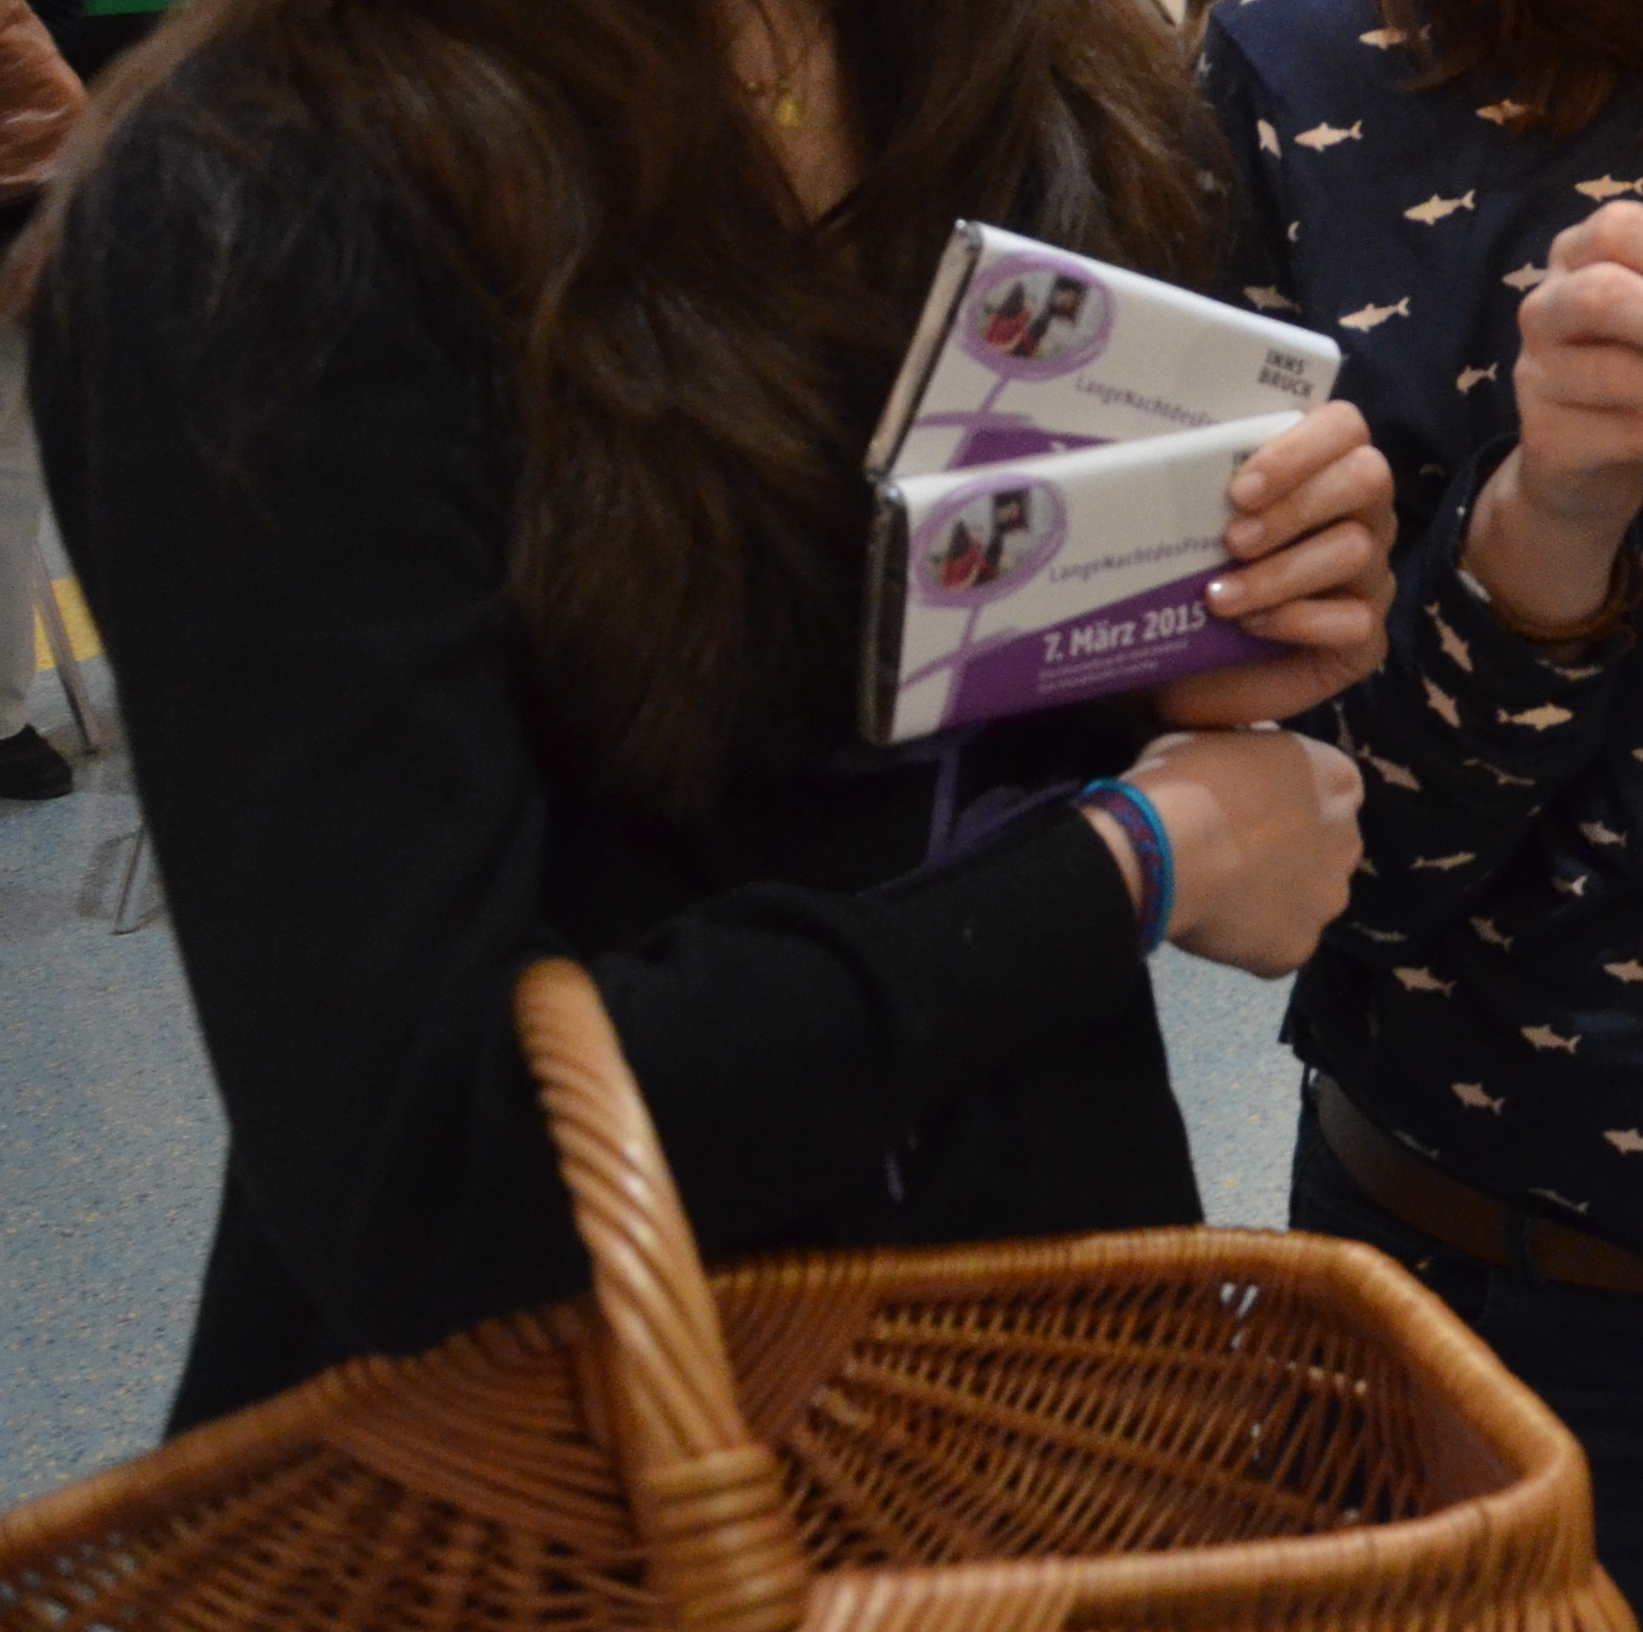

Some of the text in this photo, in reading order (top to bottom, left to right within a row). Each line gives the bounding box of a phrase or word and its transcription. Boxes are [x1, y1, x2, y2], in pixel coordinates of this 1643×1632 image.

[1075, 377, 1219, 428] LangeNachtdesFr
[1069, 620, 1137, 657] März
[1142, 600, 1207, 642] 2015
